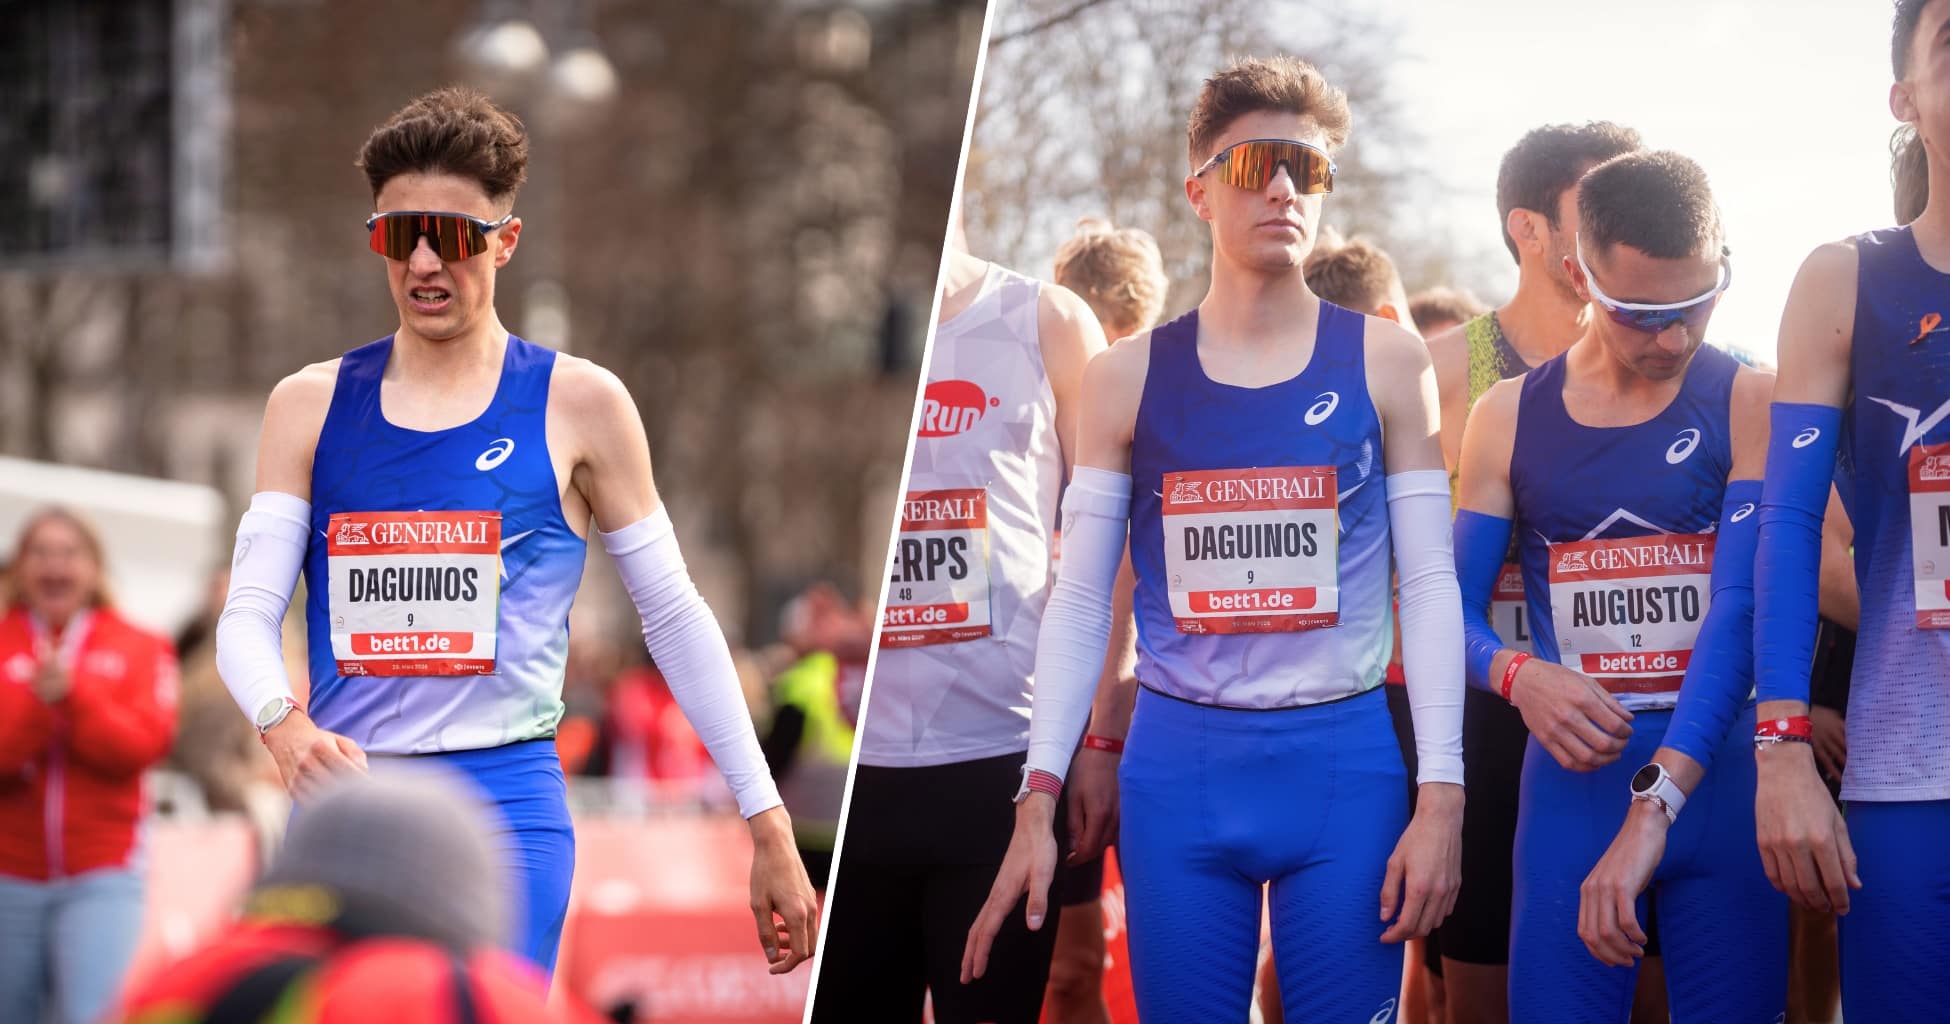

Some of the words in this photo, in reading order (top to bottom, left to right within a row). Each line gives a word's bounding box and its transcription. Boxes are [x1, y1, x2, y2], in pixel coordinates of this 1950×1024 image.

[1205, 476, 1325, 502] GENERALI
[371, 521, 488, 545] GENERALI
[1184, 522, 1318, 561] DAGUINOS
[1590, 543, 1706, 571] GENERALI
[348, 566, 478, 602] DAGUINOS
[1247, 570, 1254, 584] 9
[899, 587, 912, 601] 48
[1208, 590, 1294, 610] bett1.de
[1573, 585, 1700, 628] AUGUSTO
[407, 613, 414, 627] 9
[370, 634, 450, 652] bett1.de
[1630, 634, 1642, 648] 12
[1600, 653, 1678, 671] bett1.de
